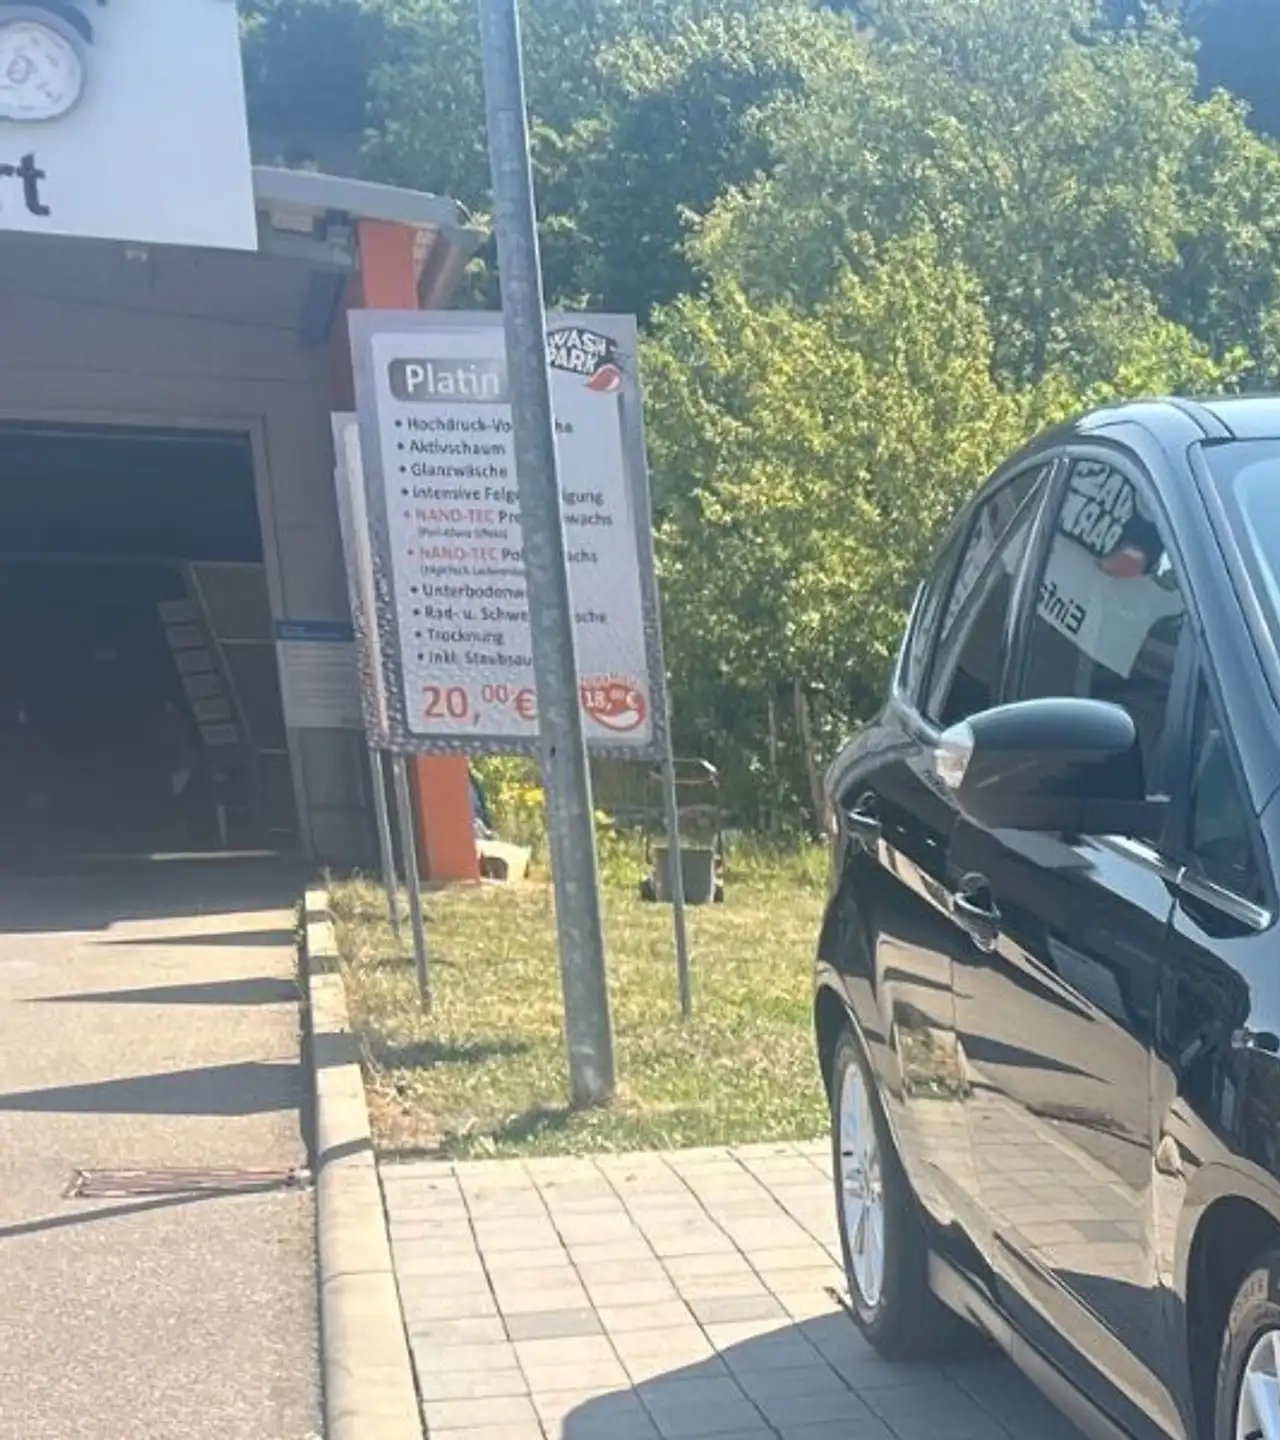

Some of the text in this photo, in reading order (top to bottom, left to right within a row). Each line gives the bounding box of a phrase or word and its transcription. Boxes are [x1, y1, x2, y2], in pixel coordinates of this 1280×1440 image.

[404, 362, 500, 397] Platin
[409, 440, 506, 456] Aktivschaum
[427, 627, 504, 645] Trocknung
